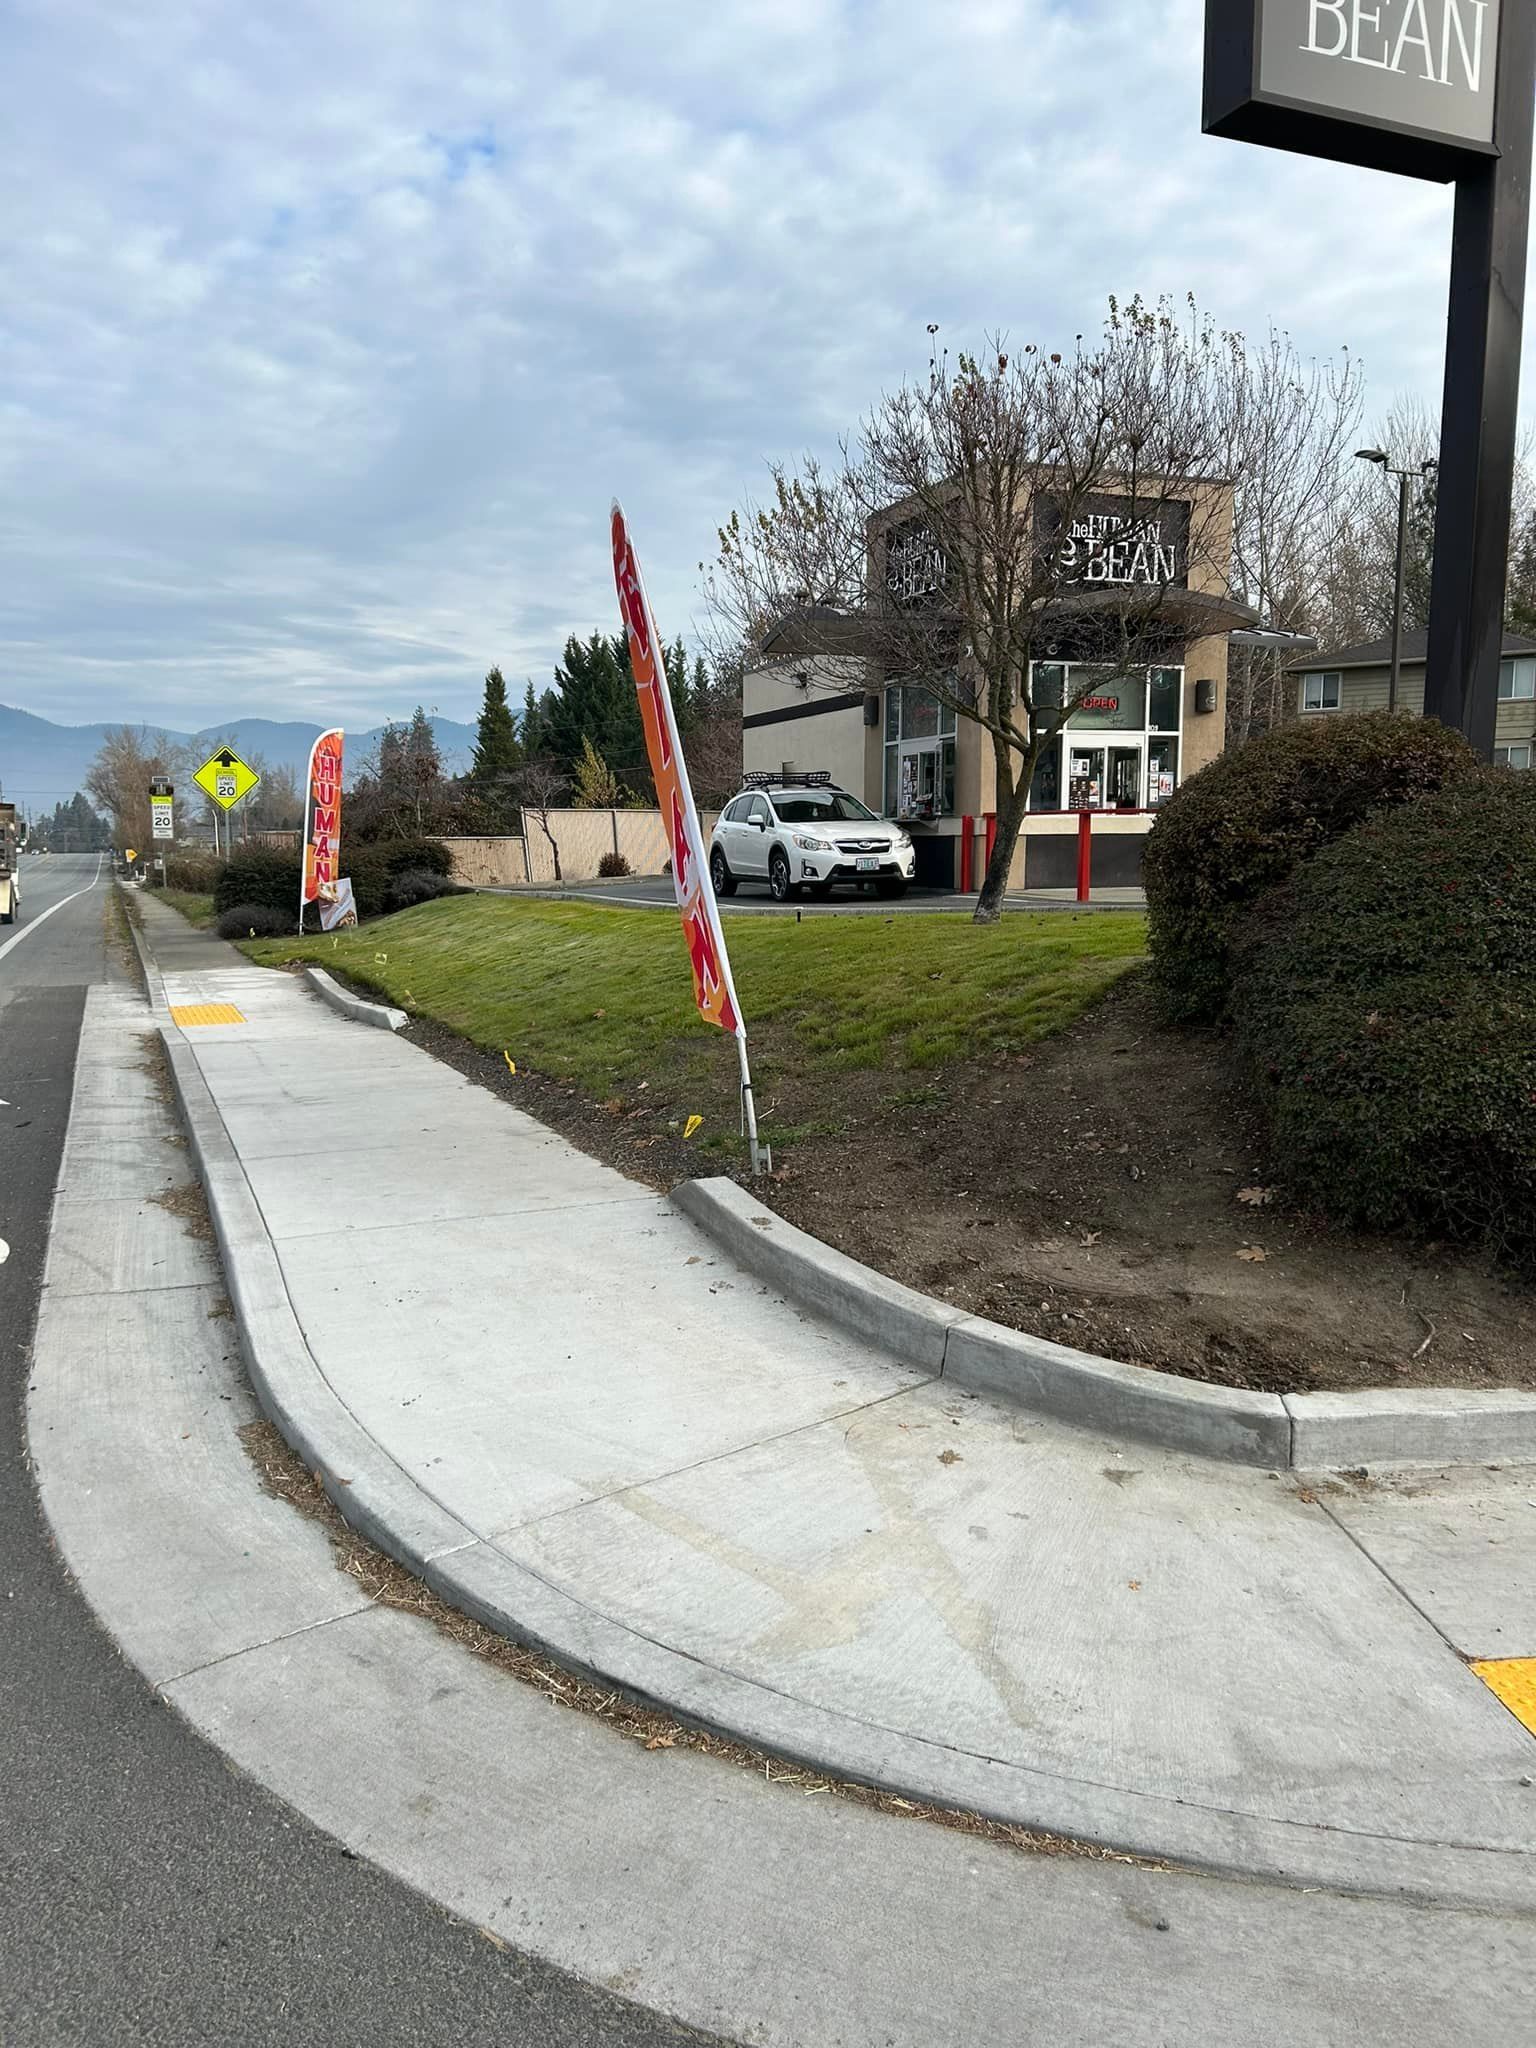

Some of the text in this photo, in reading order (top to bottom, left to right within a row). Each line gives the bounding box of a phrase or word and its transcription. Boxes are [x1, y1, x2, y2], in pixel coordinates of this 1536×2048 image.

[1299, 0, 1488, 92] BEAN
[1083, 539, 1176, 586] BEAN
[1081, 696, 1118, 711] OPEN
[218, 786, 235, 796] 20
[154, 816, 170, 826] 20
[314, 755, 336, 884] HUMAN
